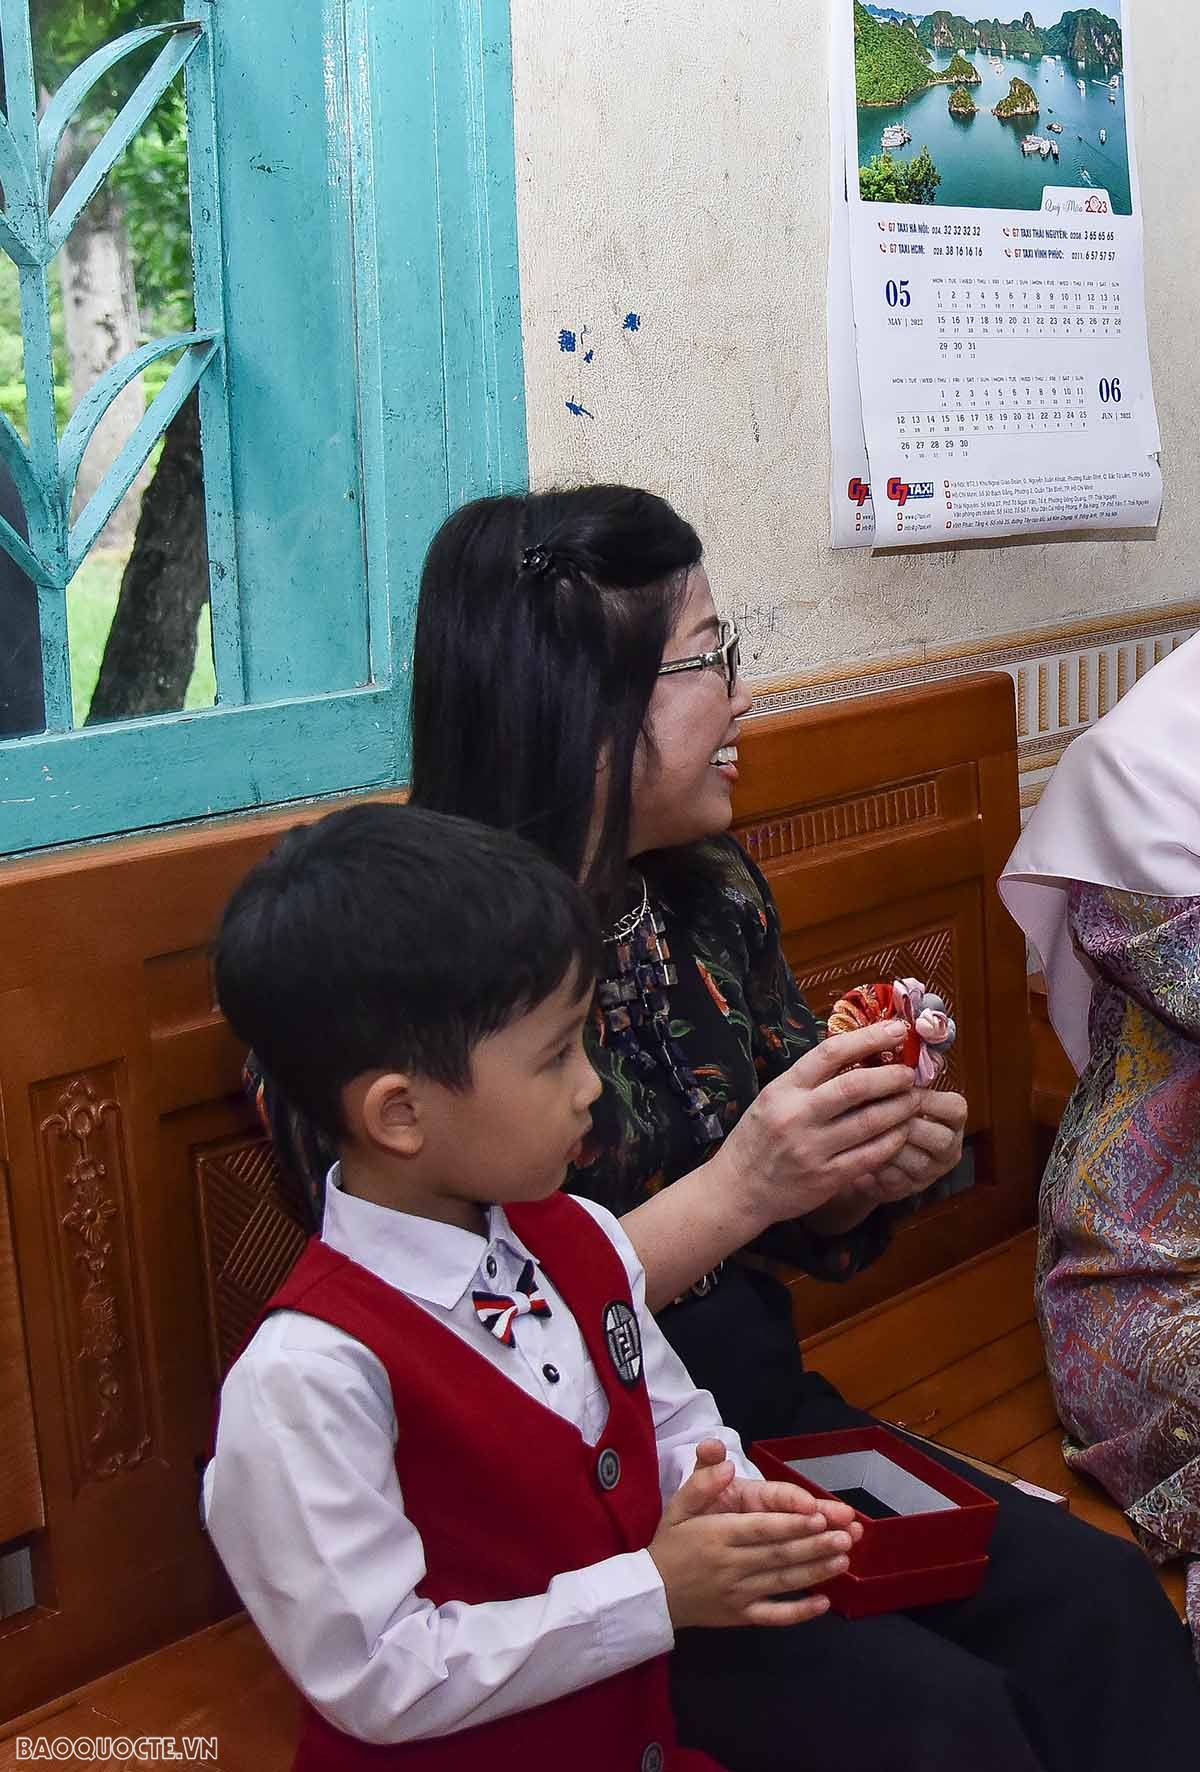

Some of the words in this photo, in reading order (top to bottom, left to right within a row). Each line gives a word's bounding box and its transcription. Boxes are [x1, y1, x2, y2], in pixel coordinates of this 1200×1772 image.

[889, 223, 895, 232] G7
[897, 223, 908, 232] TAXI
[944, 226, 951, 235] 32
[954, 226, 961, 235] 32
[963, 226, 970, 236] 32
[973, 227, 980, 236] 32
[1013, 228, 1019, 236] G7
[1021, 229, 1031, 238] TAXI
[1090, 231, 1096, 240] 65
[1098, 232, 1105, 240] 65
[1107, 232, 1114, 240] 65
[890, 244, 896, 253] G7
[898, 244, 910, 254] TAXI
[946, 246, 953, 255] 38
[956, 246, 963, 256] 16
[966, 247, 972, 256] 16
[975, 247, 982, 256] 16
[1014, 249, 1021, 257] G7
[1023, 249, 1033, 258] TAXI
[1086, 252, 1089, 260] 6
[1091, 252, 1098, 260] 57
[1100, 252, 1106, 260] 57
[1108, 252, 1115, 261] 57
[886, 280, 910, 307] 05
[938, 291, 941, 299] 1
[952, 291, 956, 299] 2
[966, 291, 970, 299] 3
[980, 291, 984, 299] 4
[995, 291, 999, 299] 5
[1009, 292, 1013, 300] 6
[1023, 292, 1026, 300] 7
[1062, 293, 1069, 301] 10
[1101, 294, 1107, 302] 13
[1113, 294, 1119, 302] 14
[938, 316, 945, 324] 15
[952, 316, 960, 324] 16
[967, 316, 974, 324] 17
[981, 316, 988, 324] 18
[996, 316, 1002, 324] 19
[1037, 317, 1044, 325] 22
[1090, 318, 1097, 326] 26
[1103, 318, 1109, 326] 27
[941, 390, 944, 398] 1
[984, 389, 988, 397] 4
[998, 389, 1002, 397] 5
[1052, 388, 1056, 396] 9
[1099, 377, 1121, 402] 06
[897, 416, 905, 424] 12
[927, 415, 935, 423] 14
[971, 414, 978, 422] 17
[1014, 412, 1021, 420] 20
[1027, 412, 1034, 420] 21
[1066, 411, 1074, 419] 24
[916, 441, 924, 449] 27
[945, 440, 953, 448] 29
[887, 477, 909, 506] G7
[909, 483, 933, 494] TAXI
